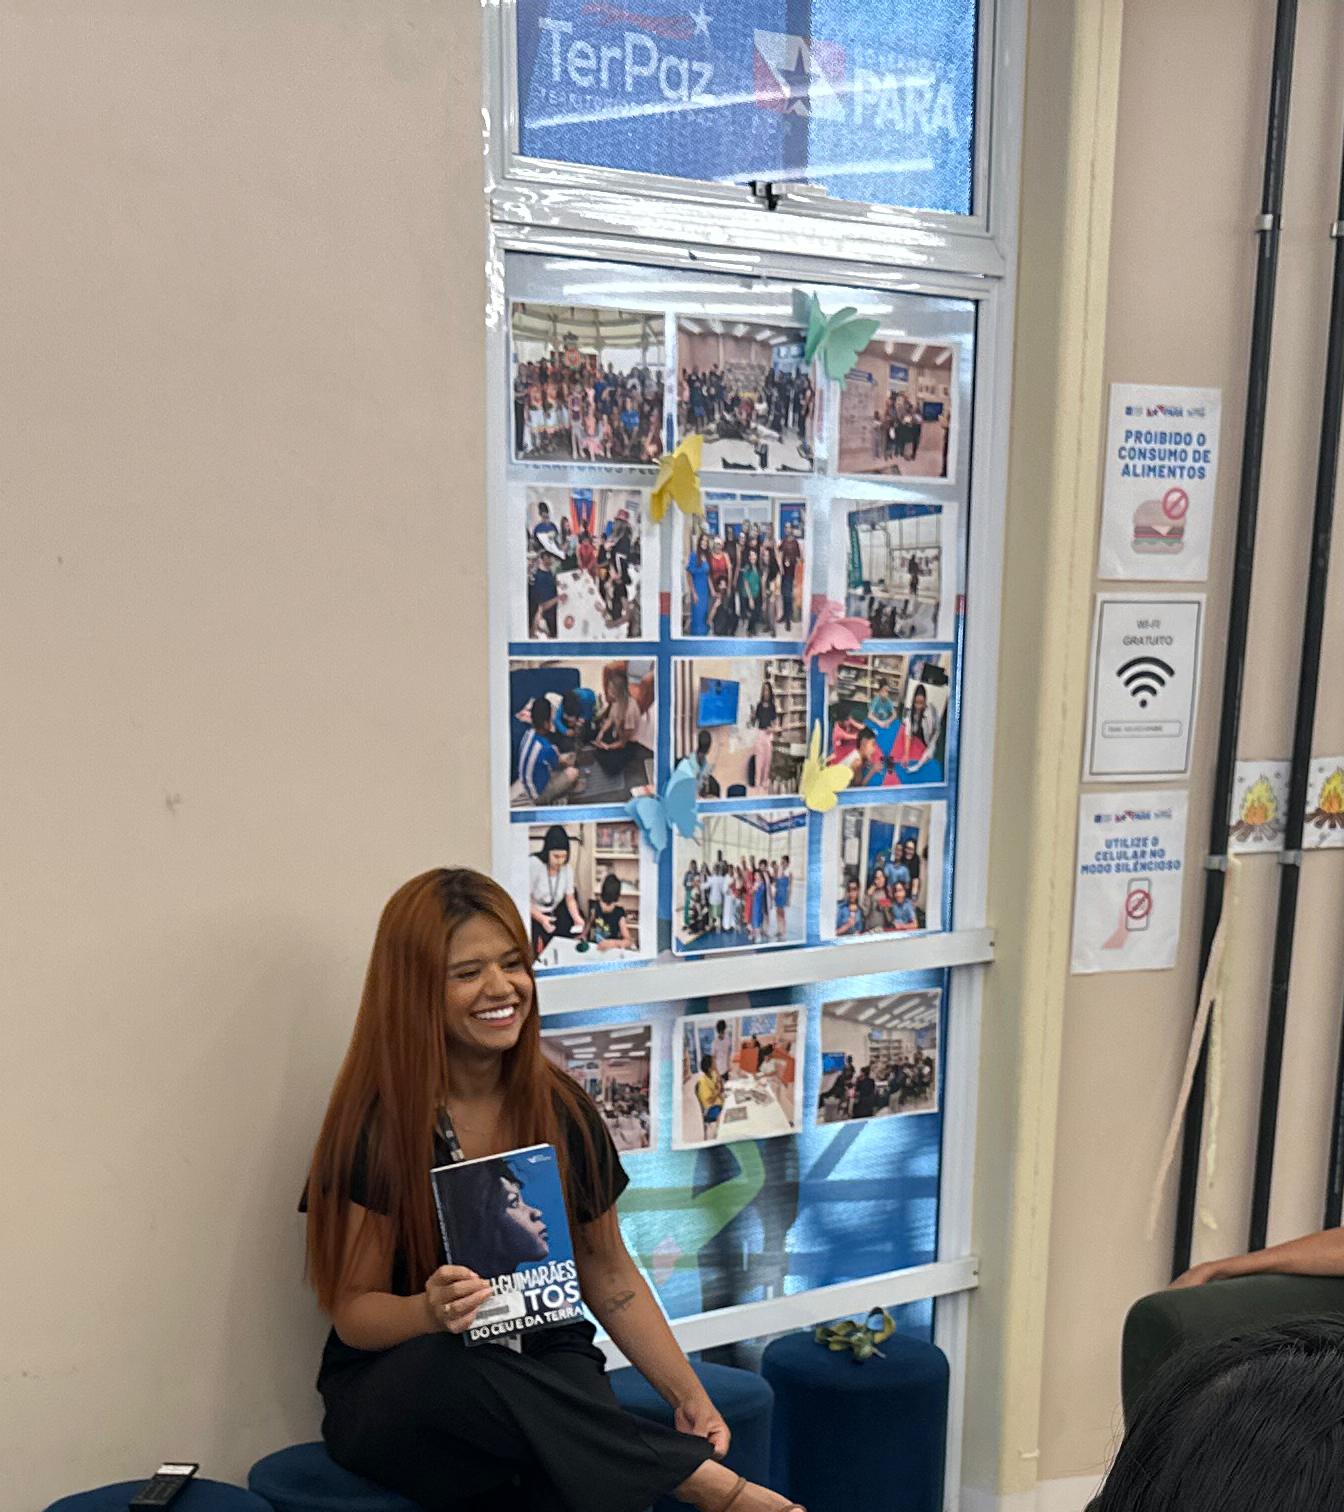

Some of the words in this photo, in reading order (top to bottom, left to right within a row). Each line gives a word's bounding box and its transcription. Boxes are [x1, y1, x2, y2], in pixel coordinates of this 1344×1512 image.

[539, 17, 714, 105] TerPaz
[1125, 430, 1192, 446] PROIBIDO
[1196, 432, 1206, 446] O
[1118, 446, 1188, 463] CONSUMO
[1192, 450, 1211, 463] DE
[1121, 463, 1206, 480] ALIMENTOS
[1095, 848, 1147, 861] CELULAR
[1150, 848, 1165, 859] NO
[1081, 863, 1112, 875] MODO
[497, 1260, 577, 1294] GUIMARÃES
[470, 1325, 490, 1341] DO
[516, 1318, 525, 1330] E
[524, 1314, 544, 1328] DA
[544, 1305, 584, 1322] TERRA
